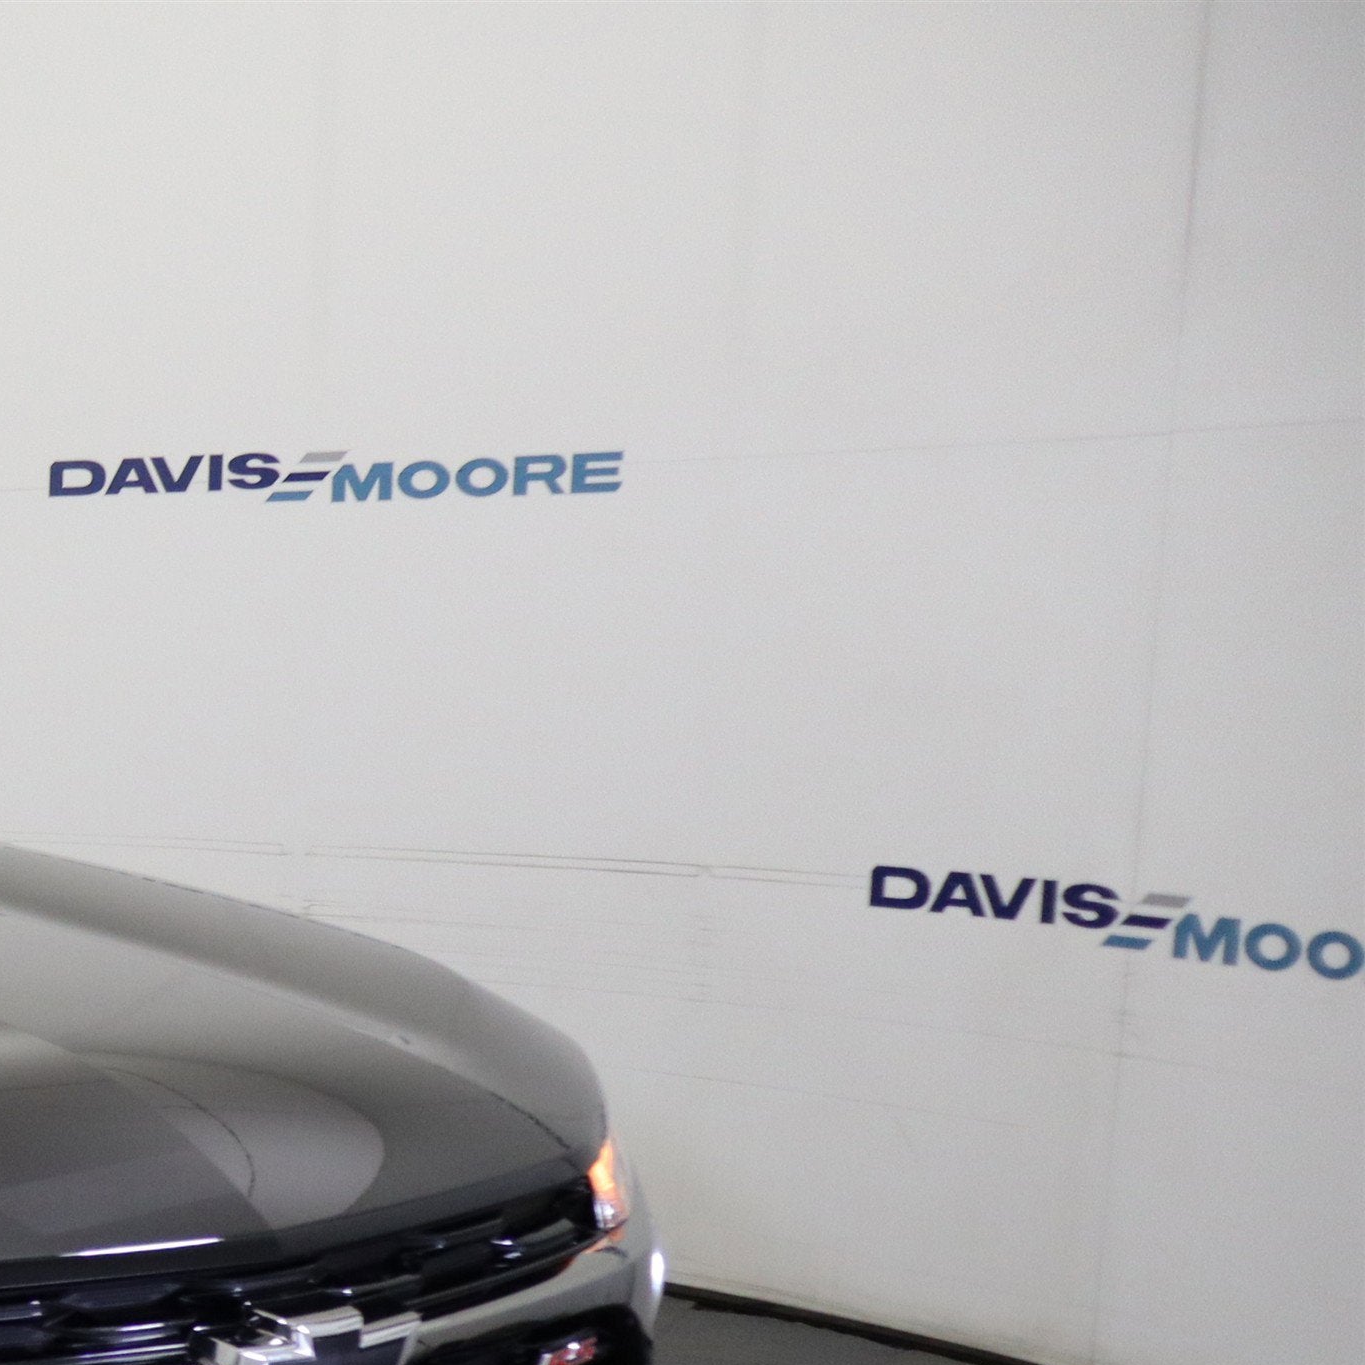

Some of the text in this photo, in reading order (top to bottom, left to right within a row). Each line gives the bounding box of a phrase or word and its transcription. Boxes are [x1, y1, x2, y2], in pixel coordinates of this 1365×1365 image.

[49, 450, 624, 503] DAVIS MOORE
[870, 864, 1121, 930] DAVIS
